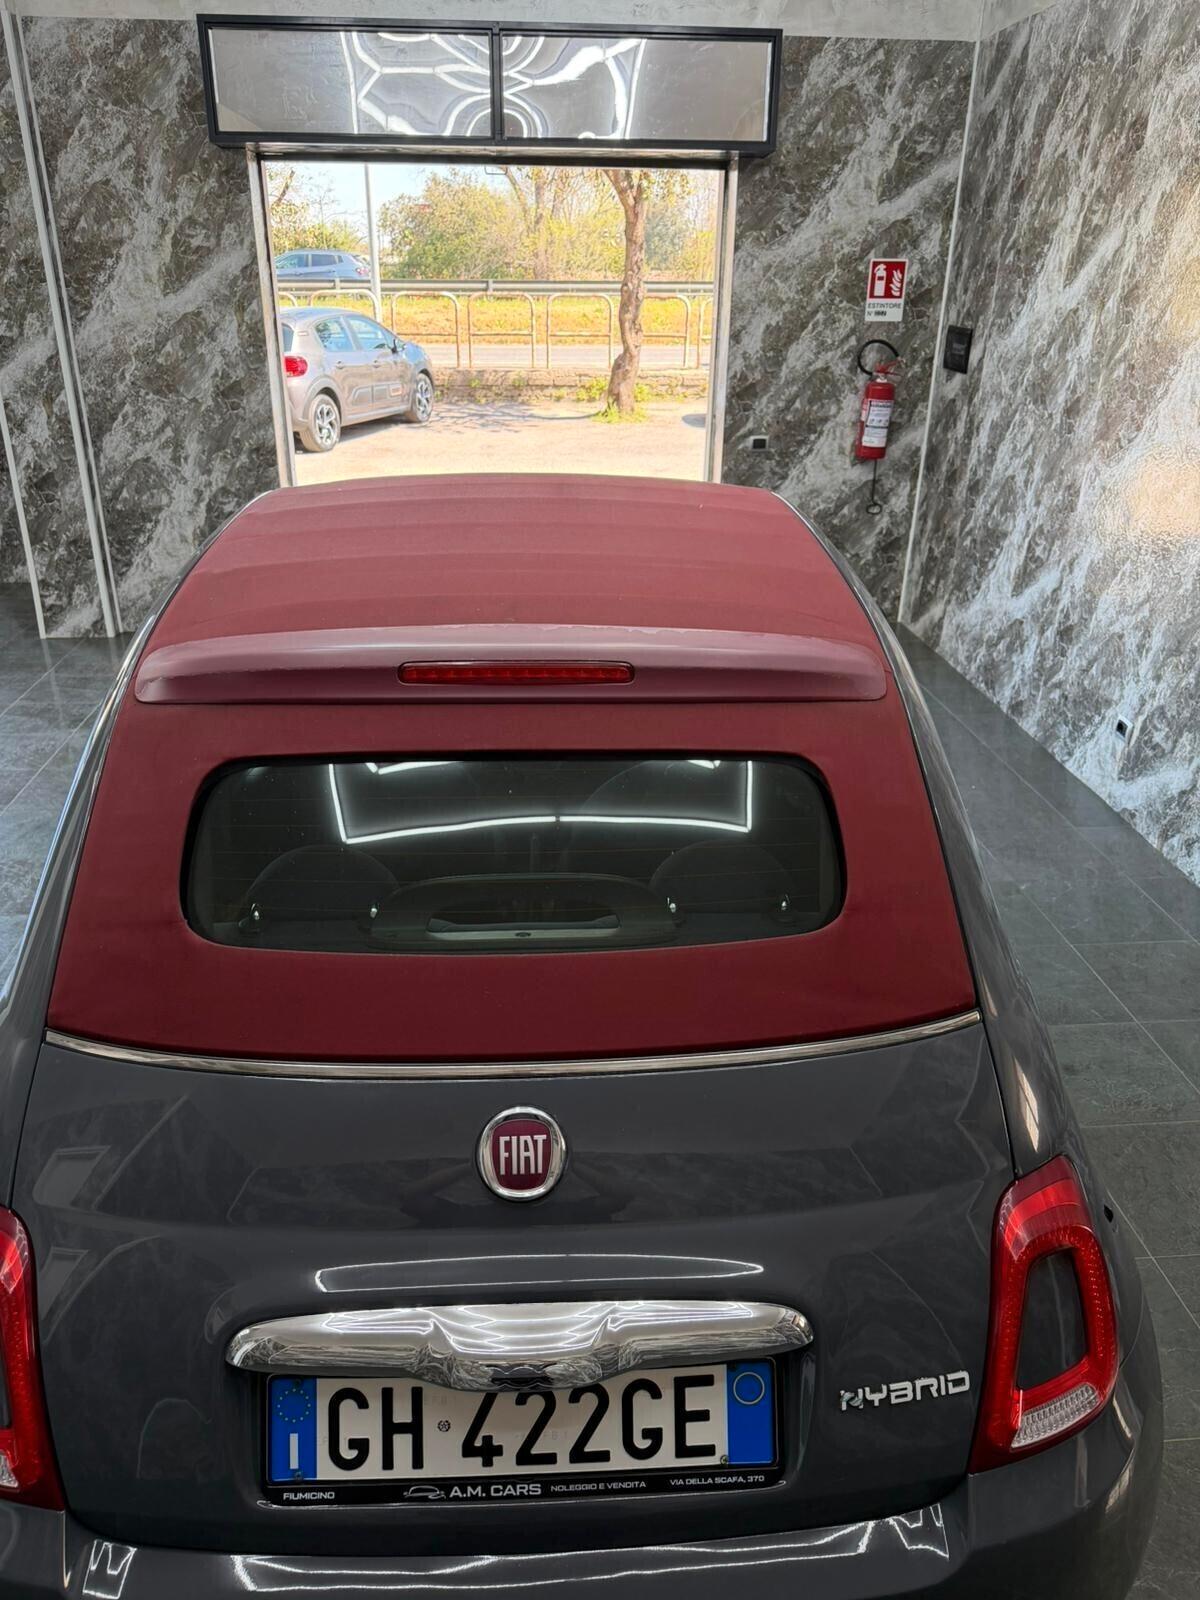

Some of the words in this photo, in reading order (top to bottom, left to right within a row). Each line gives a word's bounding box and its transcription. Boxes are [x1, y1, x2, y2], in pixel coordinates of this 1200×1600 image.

[499, 1134, 547, 1176] FIAT
[839, 1370, 970, 1411] HYBRID
[328, 1386, 424, 1471] GH
[461, 1374, 716, 1468] 422GE
[550, 1484, 596, 1493] NOLEGGIO
[599, 1482, 605, 1490] E
[607, 1481, 647, 1490] VENDITA
[669, 1479, 684, 1487] VIA
[685, 1477, 713, 1486] DELLA
[714, 1476, 746, 1485] SCAFA,
[747, 1475, 765, 1483] 370
[283, 1491, 335, 1500] FIUMICINO
[449, 1486, 486, 1498] A.M.
[490, 1483, 542, 1497] CARS
